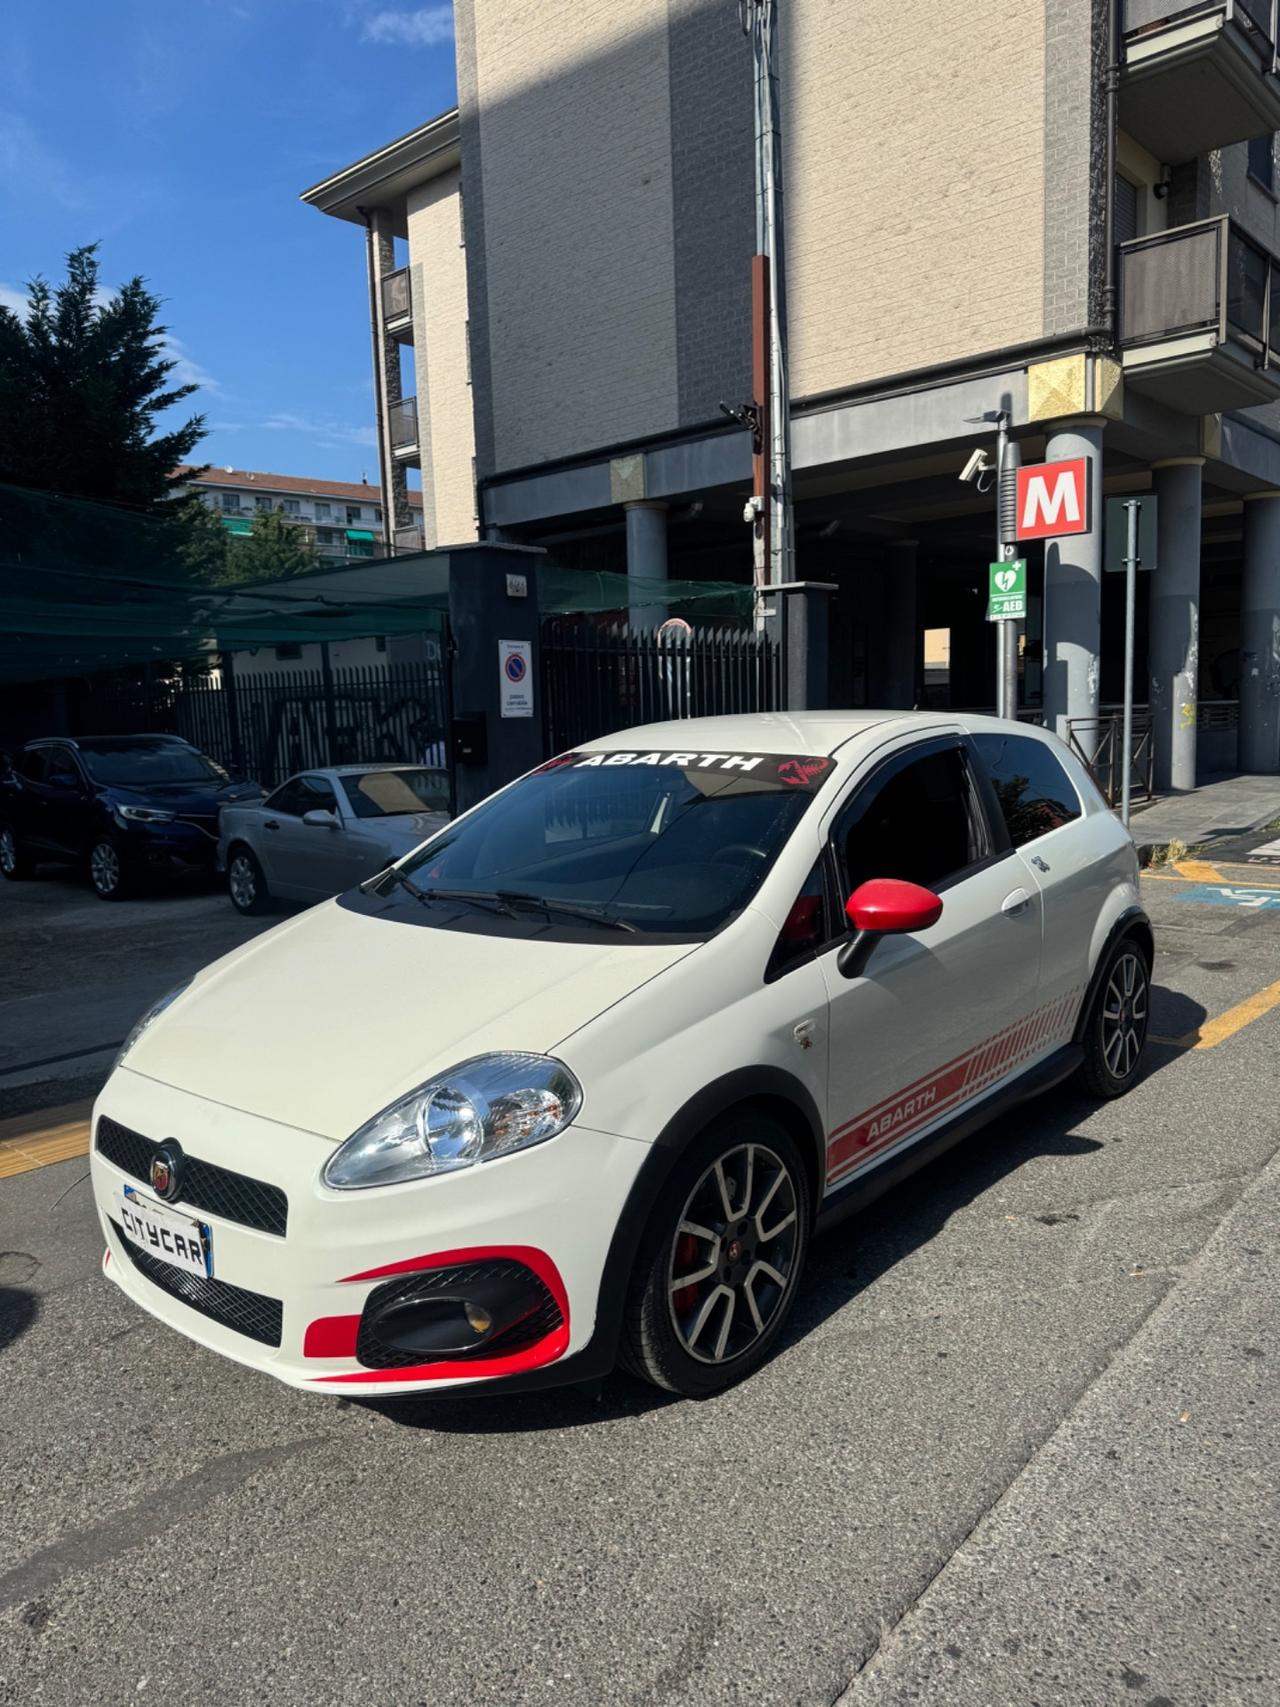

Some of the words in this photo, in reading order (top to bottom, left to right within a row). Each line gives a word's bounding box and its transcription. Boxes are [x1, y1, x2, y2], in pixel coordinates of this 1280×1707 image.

[1022, 471, 1080, 528] M
[1003, 600, 1022, 612] AED
[574, 752, 764, 772] ABARTH
[866, 1086, 937, 1143] ABARTH
[121, 1207, 203, 1266] CITYCAR
